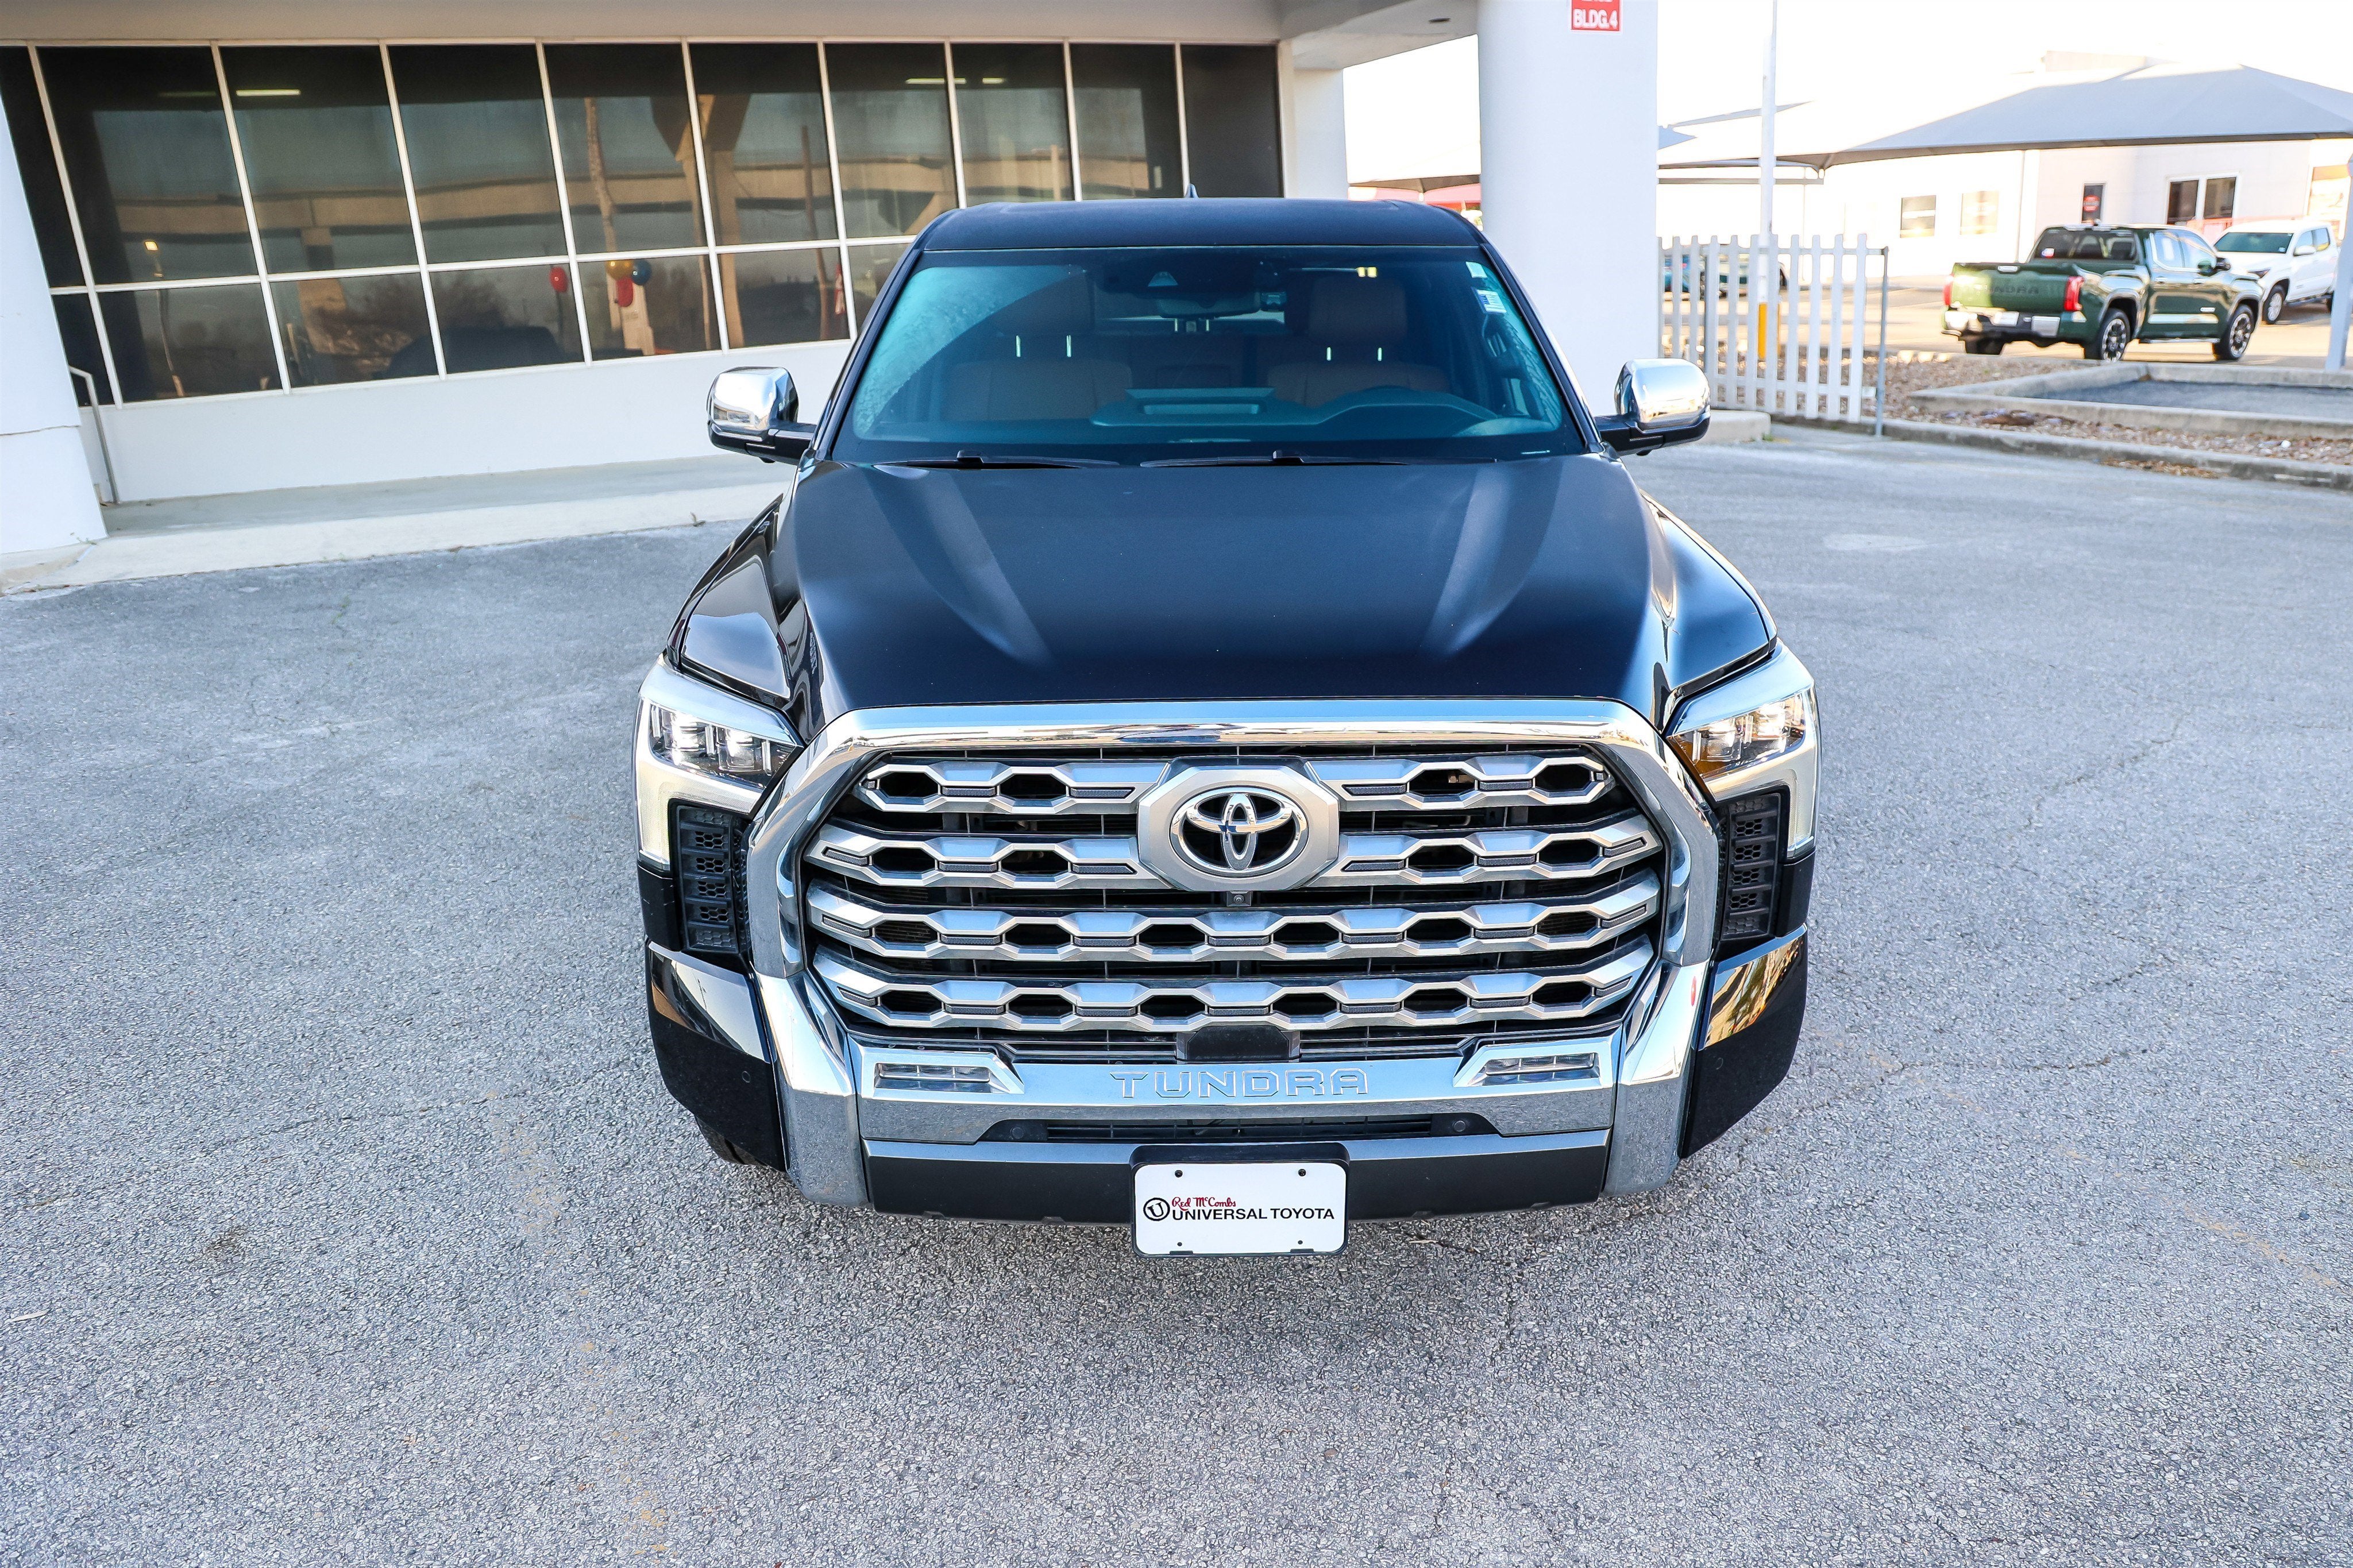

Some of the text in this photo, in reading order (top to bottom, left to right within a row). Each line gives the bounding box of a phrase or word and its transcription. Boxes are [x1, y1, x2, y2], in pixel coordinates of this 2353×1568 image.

[1109, 1068, 1368, 1098] TUNDRA
[1172, 1196, 1236, 1211] Red McCombs
[1172, 1207, 1335, 1221] UNIVERSAL TOYOTA
